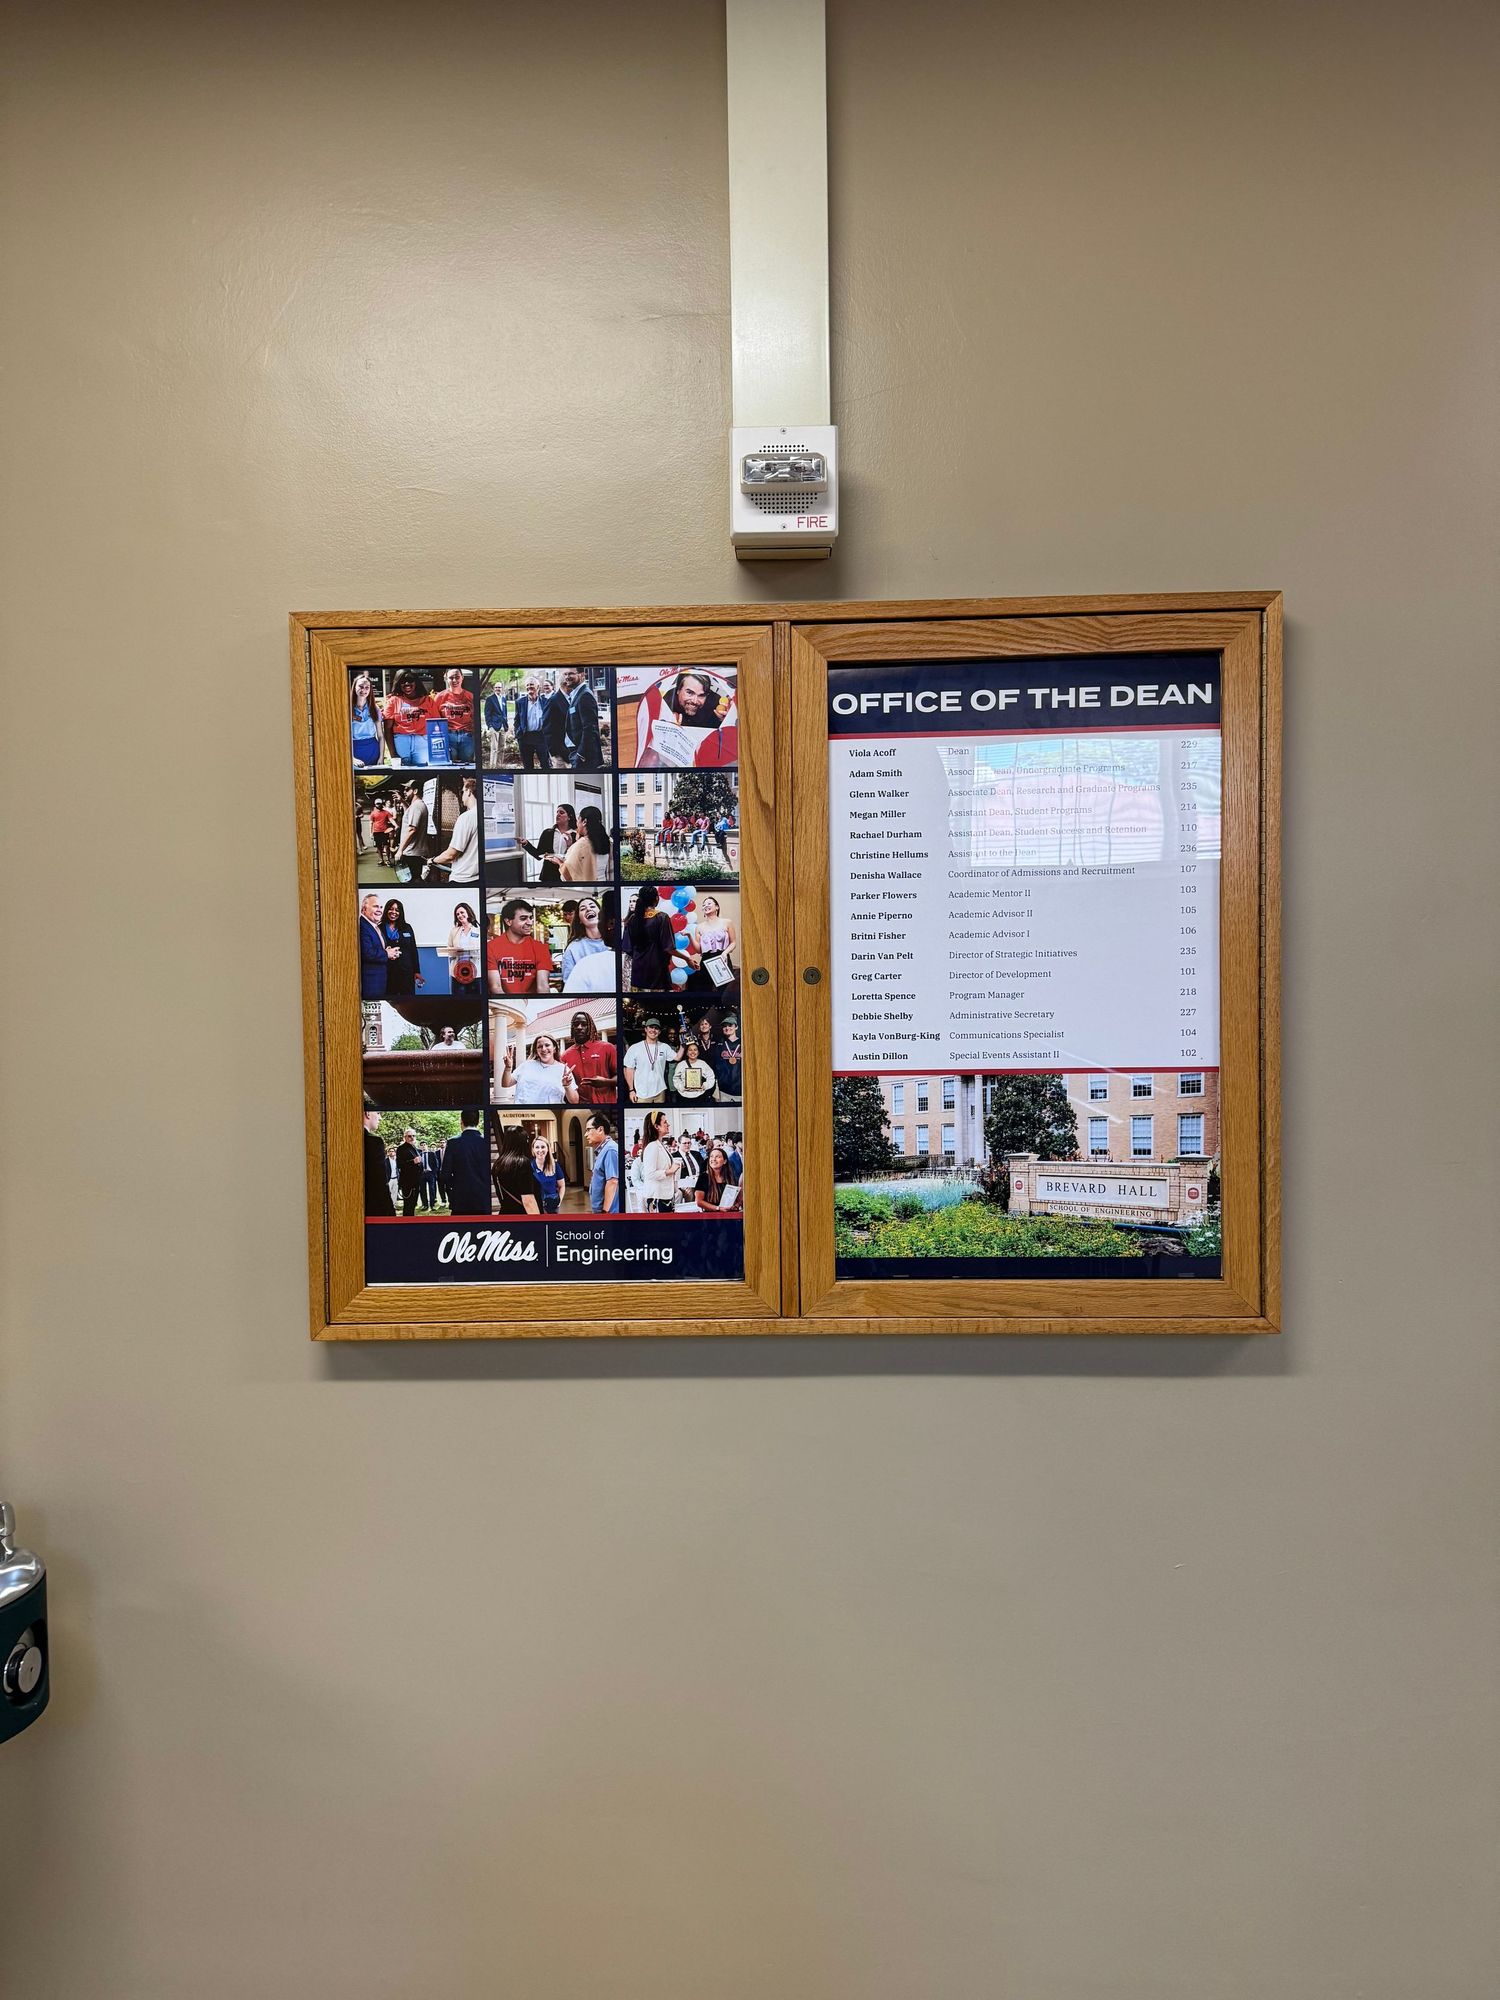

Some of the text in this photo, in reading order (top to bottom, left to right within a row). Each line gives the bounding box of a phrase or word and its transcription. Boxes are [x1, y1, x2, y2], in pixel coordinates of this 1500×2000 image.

[797, 516, 828, 528] FIRE
[832, 684, 1212, 715] OFFICE OF THE DEAN
[849, 748, 897, 757] Viola Acoff
[948, 747, 969, 755] Dean
[1016, 765, 1081, 776] Undergraduate
[1083, 764, 1125, 774] Programs
[1180, 761, 1197, 770] 217
[849, 769, 903, 778] Adam Smith
[948, 784, 1161, 797] Associate Dean, Research and Graduate Programs
[1180, 782, 1197, 790] 235
[849, 790, 909, 798] Glenn Walker
[1180, 803, 1197, 811] 214
[849, 810, 906, 820] Megan Miller
[948, 806, 1092, 818] Assistant Dean, Student Programs
[948, 825, 1147, 837] Assistant Dean, Student Success and Retention
[1180, 824, 1197, 832] 110
[850, 830, 922, 839] Rachael Durham
[948, 849, 988, 858] Assistant
[989, 849, 997, 857] to
[1015, 848, 1036, 856] Dean
[1180, 844, 1197, 853] 236
[850, 851, 929, 859] Christine Hellums
[948, 866, 1135, 878] Coordinator of Admissions and Recruitment
[1180, 865, 1197, 873] 107
[850, 871, 922, 880] Denisha Wallace
[948, 889, 1031, 899] Academic Mentor II
[1180, 886, 1197, 894] 103
[850, 891, 917, 900] Parker Flowers
[948, 909, 1033, 919] Academic Advisor II
[1180, 906, 1197, 914] 105
[850, 912, 913, 921] Annie Piperno
[948, 930, 1030, 939] Academic Advisor I
[1180, 926, 1197, 935] 106
[851, 932, 876, 940] Britni
[949, 949, 1078, 959] Director of Strategic Initiatives
[1180, 947, 1197, 955] 235
[851, 952, 914, 960] Darin Van Pelt
[949, 970, 1052, 979] Director of Development
[1180, 968, 1196, 976] 101
[851, 972, 902, 982] Greg Carter
[884, 992, 916, 1001] Spence
[949, 991, 1025, 1000] Program Manager
[1180, 988, 1197, 996] 218
[852, 1012, 913, 1021] Debbie Shelby
[949, 1010, 1054, 1019] Administrative Secretary
[1180, 1008, 1197, 1016] 227
[852, 1032, 941, 1042] Kayla VonBurg-King
[949, 1030, 1065, 1040] Communications Specialist
[1180, 1028, 1197, 1037] 104
[852, 1052, 908, 1061] Austin Dillon
[949, 1050, 1060, 1060] Special Events Assistant II
[1180, 1049, 1197, 1057] 102
[1046, 1181, 1158, 1197] BREVARD HALL
[1049, 1204, 1079, 1213] SCHOOL
[1094, 1207, 1152, 1218] ENGINEERING
[555, 1230, 605, 1241] School of
[437, 1230, 538, 1264] Ole Miss
[556, 1244, 673, 1265] Engineering
